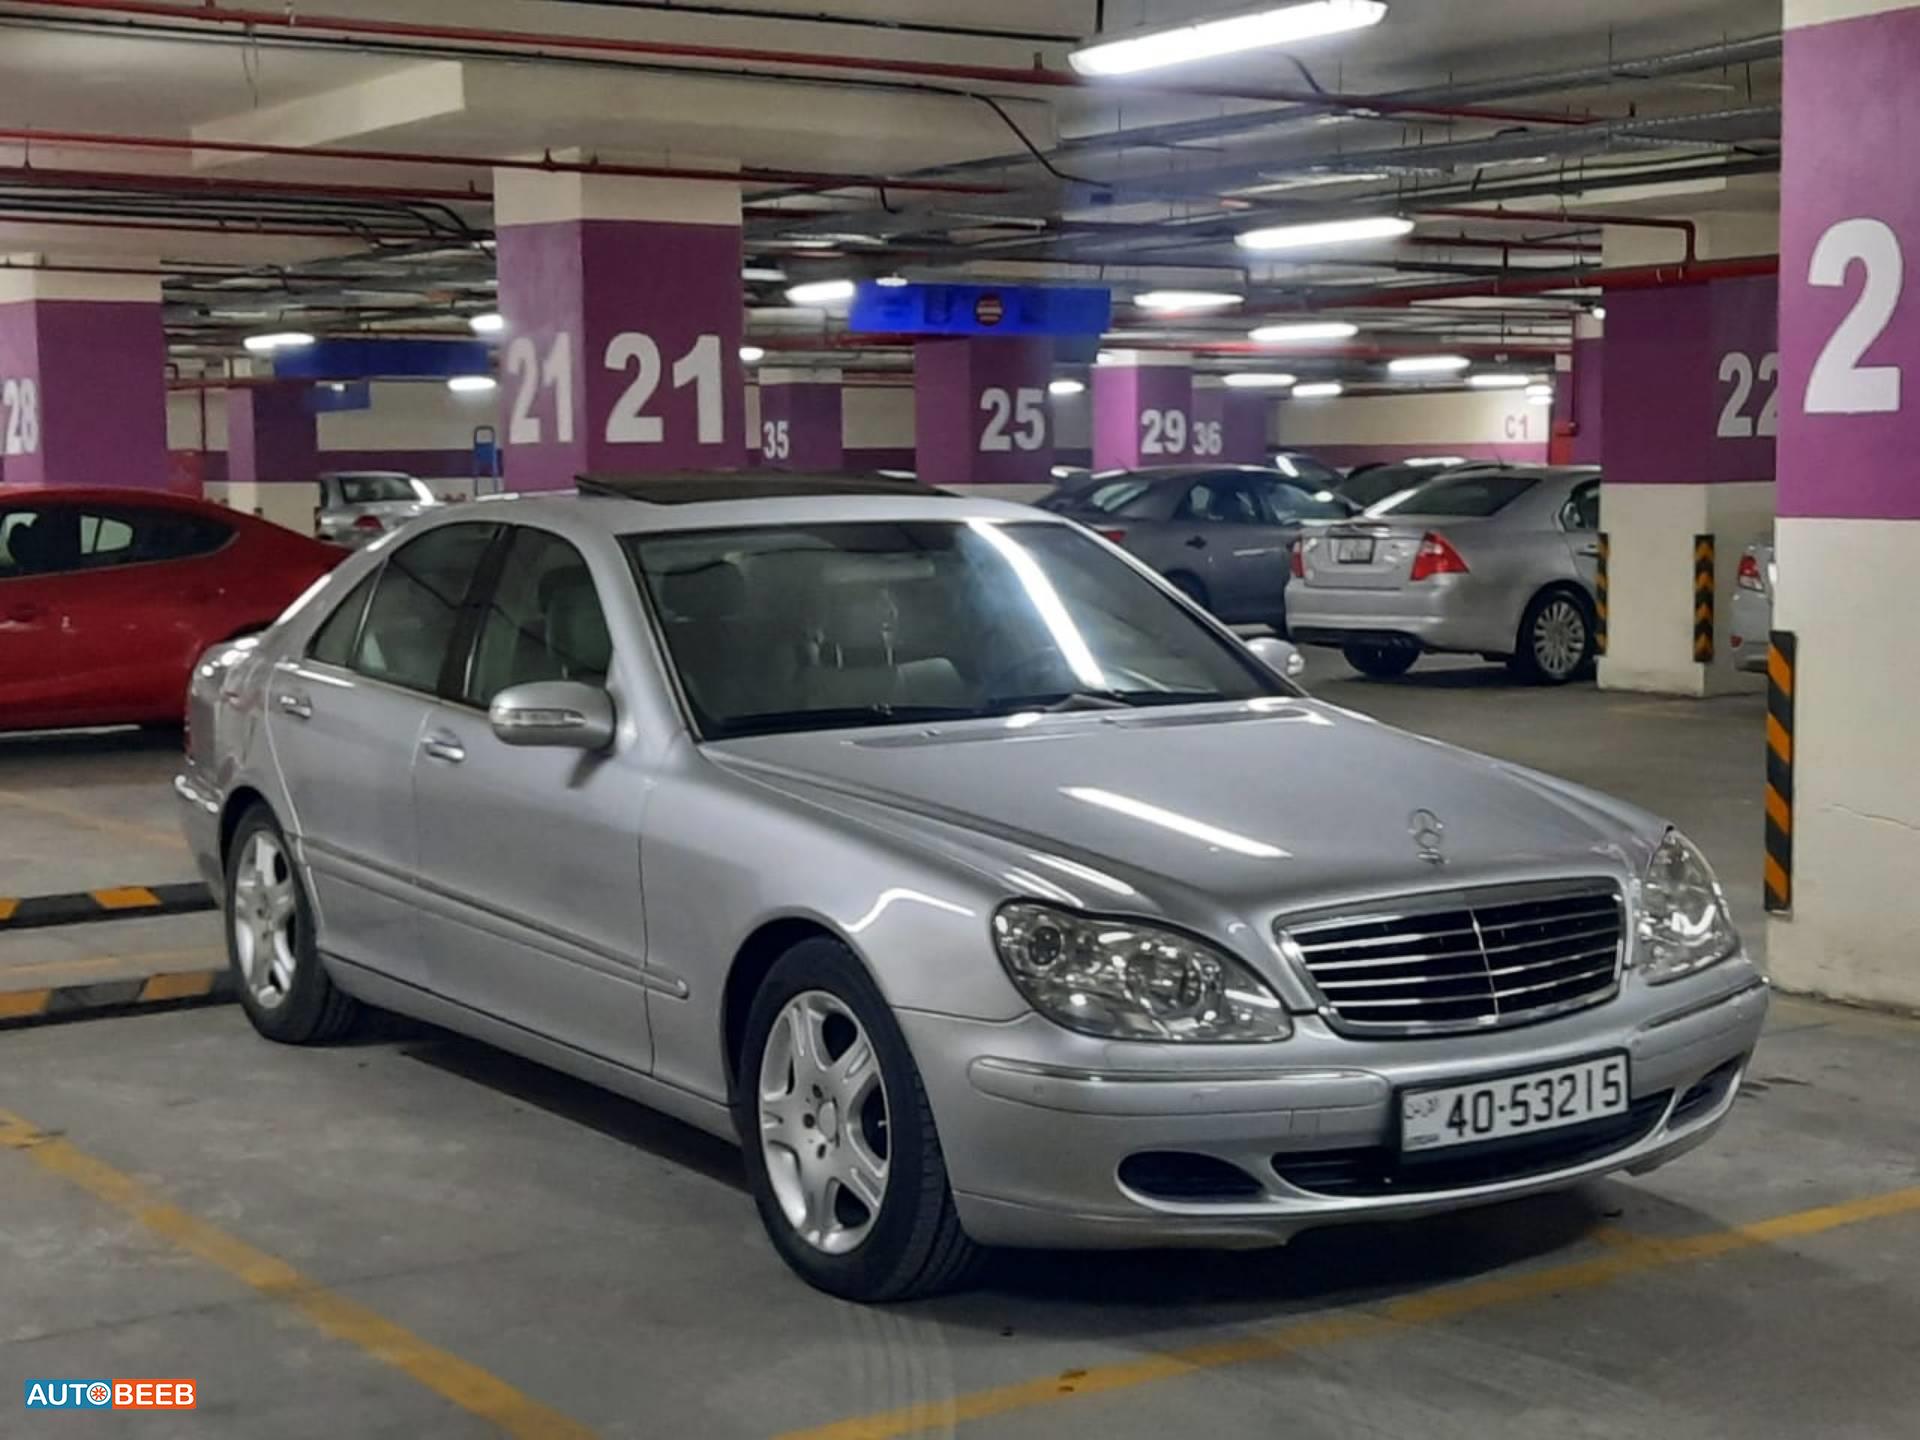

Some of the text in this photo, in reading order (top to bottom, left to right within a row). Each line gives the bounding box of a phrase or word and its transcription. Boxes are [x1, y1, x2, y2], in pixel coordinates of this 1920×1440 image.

[1804, 217, 1904, 414] 2
[2, 379, 39, 455] 28
[507, 332, 573, 444] 21
[604, 332, 724, 444] 21
[980, 388, 1046, 451] 25
[763, 420, 789, 460] 35
[1141, 409, 1187, 454] 29
[1192, 421, 1223, 455] 36
[1504, 413, 1529, 440] C1
[1445, 1063, 1621, 1137] 40-53215
